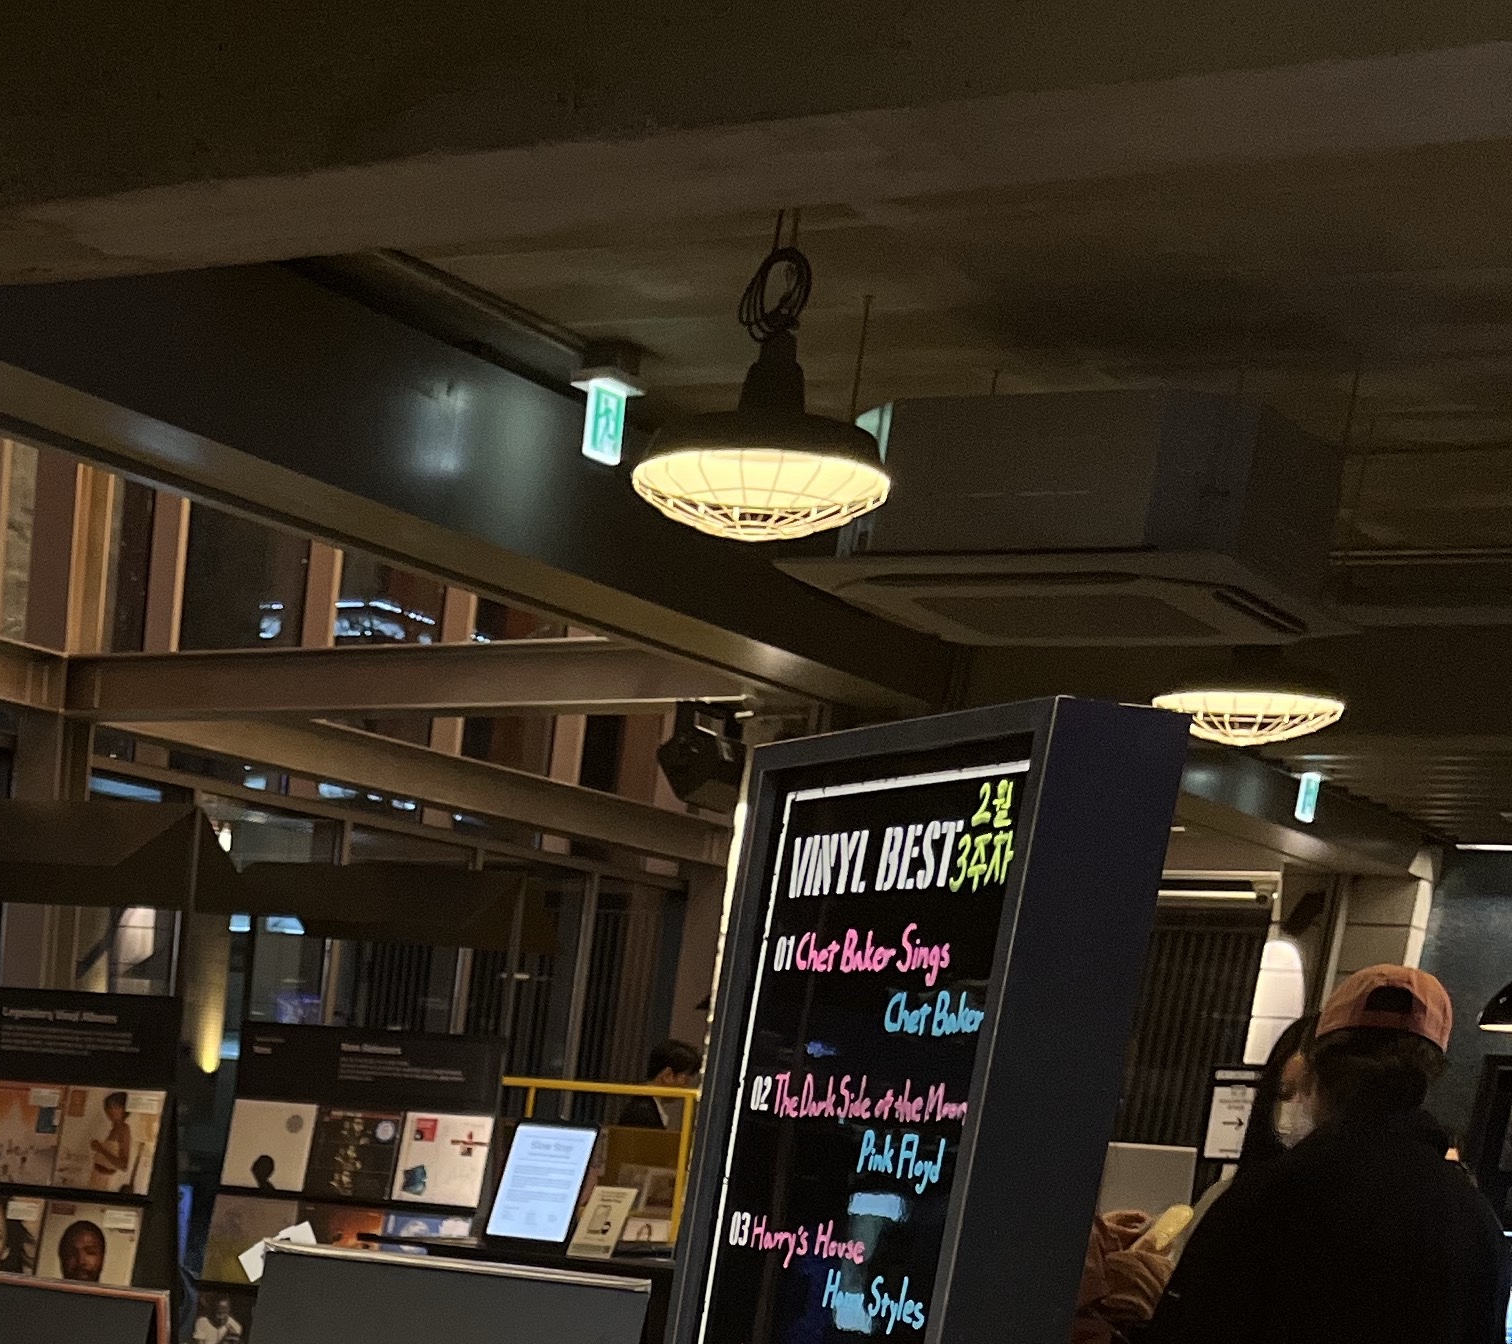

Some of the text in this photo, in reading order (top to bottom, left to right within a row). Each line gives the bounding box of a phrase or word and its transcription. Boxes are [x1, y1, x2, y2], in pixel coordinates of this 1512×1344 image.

[971, 779, 1014, 828] 2월
[788, 820, 965, 899] VINYL BEST
[948, 830, 1014, 893] 3주차
[773, 922, 951, 987] 01 Chet Baker Sings
[884, 990, 985, 1038] Chet Baker
[750, 1076, 772, 1111] 02
[774, 1071, 799, 1118] The
[799, 1073, 837, 1118] Dark
[837, 1075, 871, 1120] Side
[894, 1078, 924, 1123] the
[856, 1129, 946, 1195] Pink Floyd
[729, 1211, 865, 1269] 03 Harry's House
[868, 1275, 926, 1335] Styles
